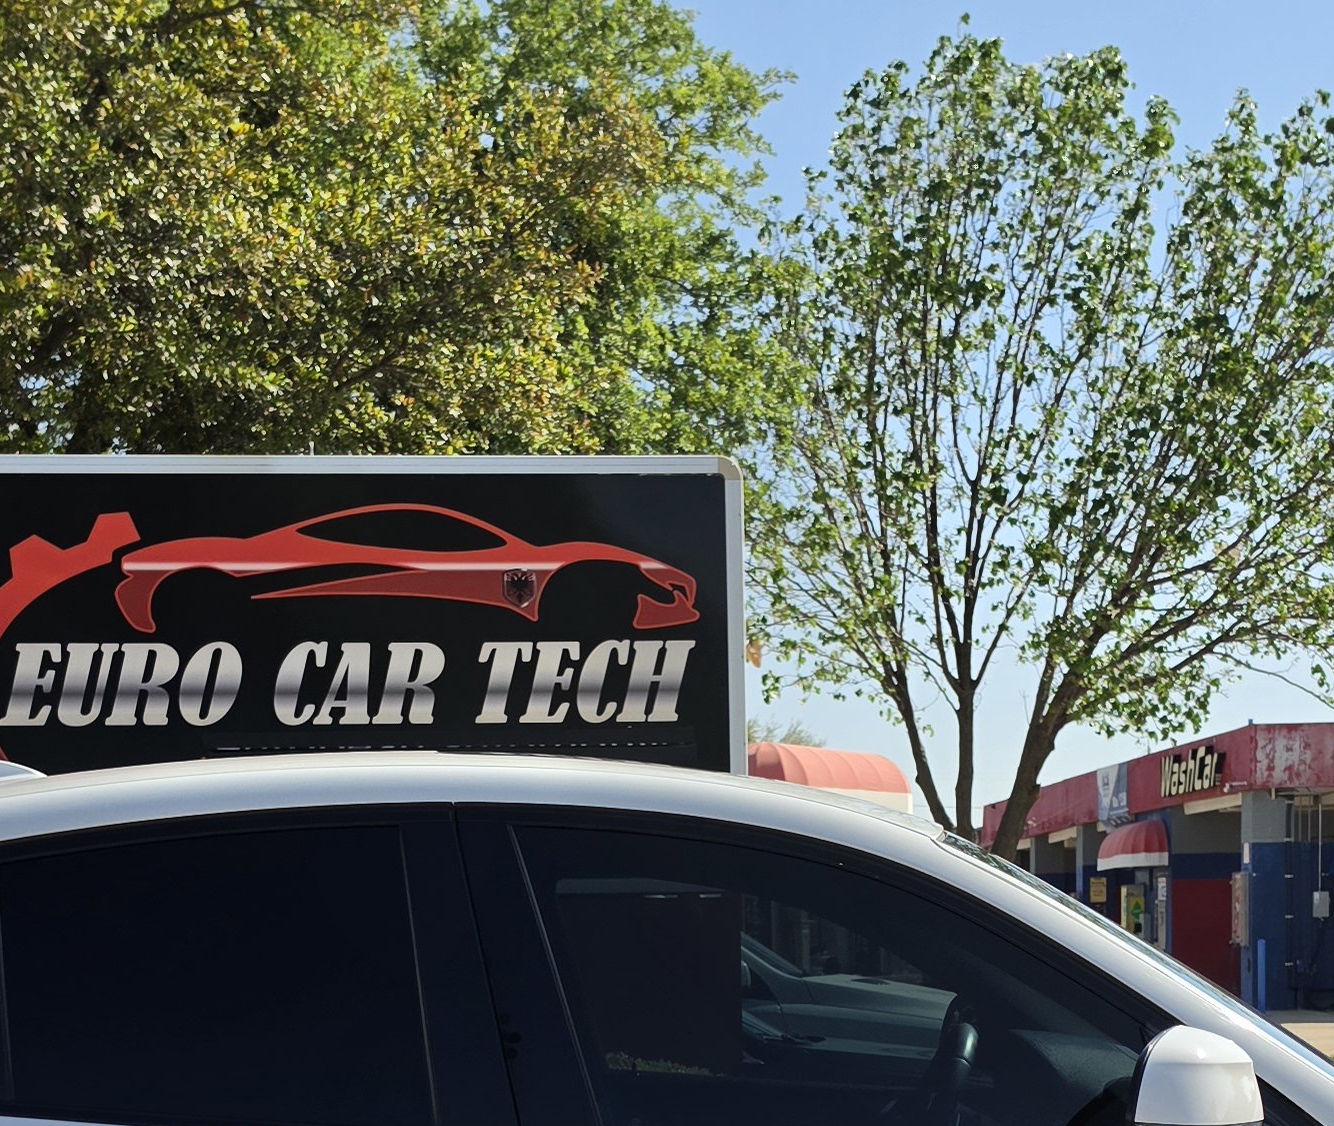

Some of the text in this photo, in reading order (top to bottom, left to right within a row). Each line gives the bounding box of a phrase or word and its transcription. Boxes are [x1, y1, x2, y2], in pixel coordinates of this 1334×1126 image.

[0, 640, 696, 726] EURO CAR TECH
[1161, 746, 1218, 798] WashCar
